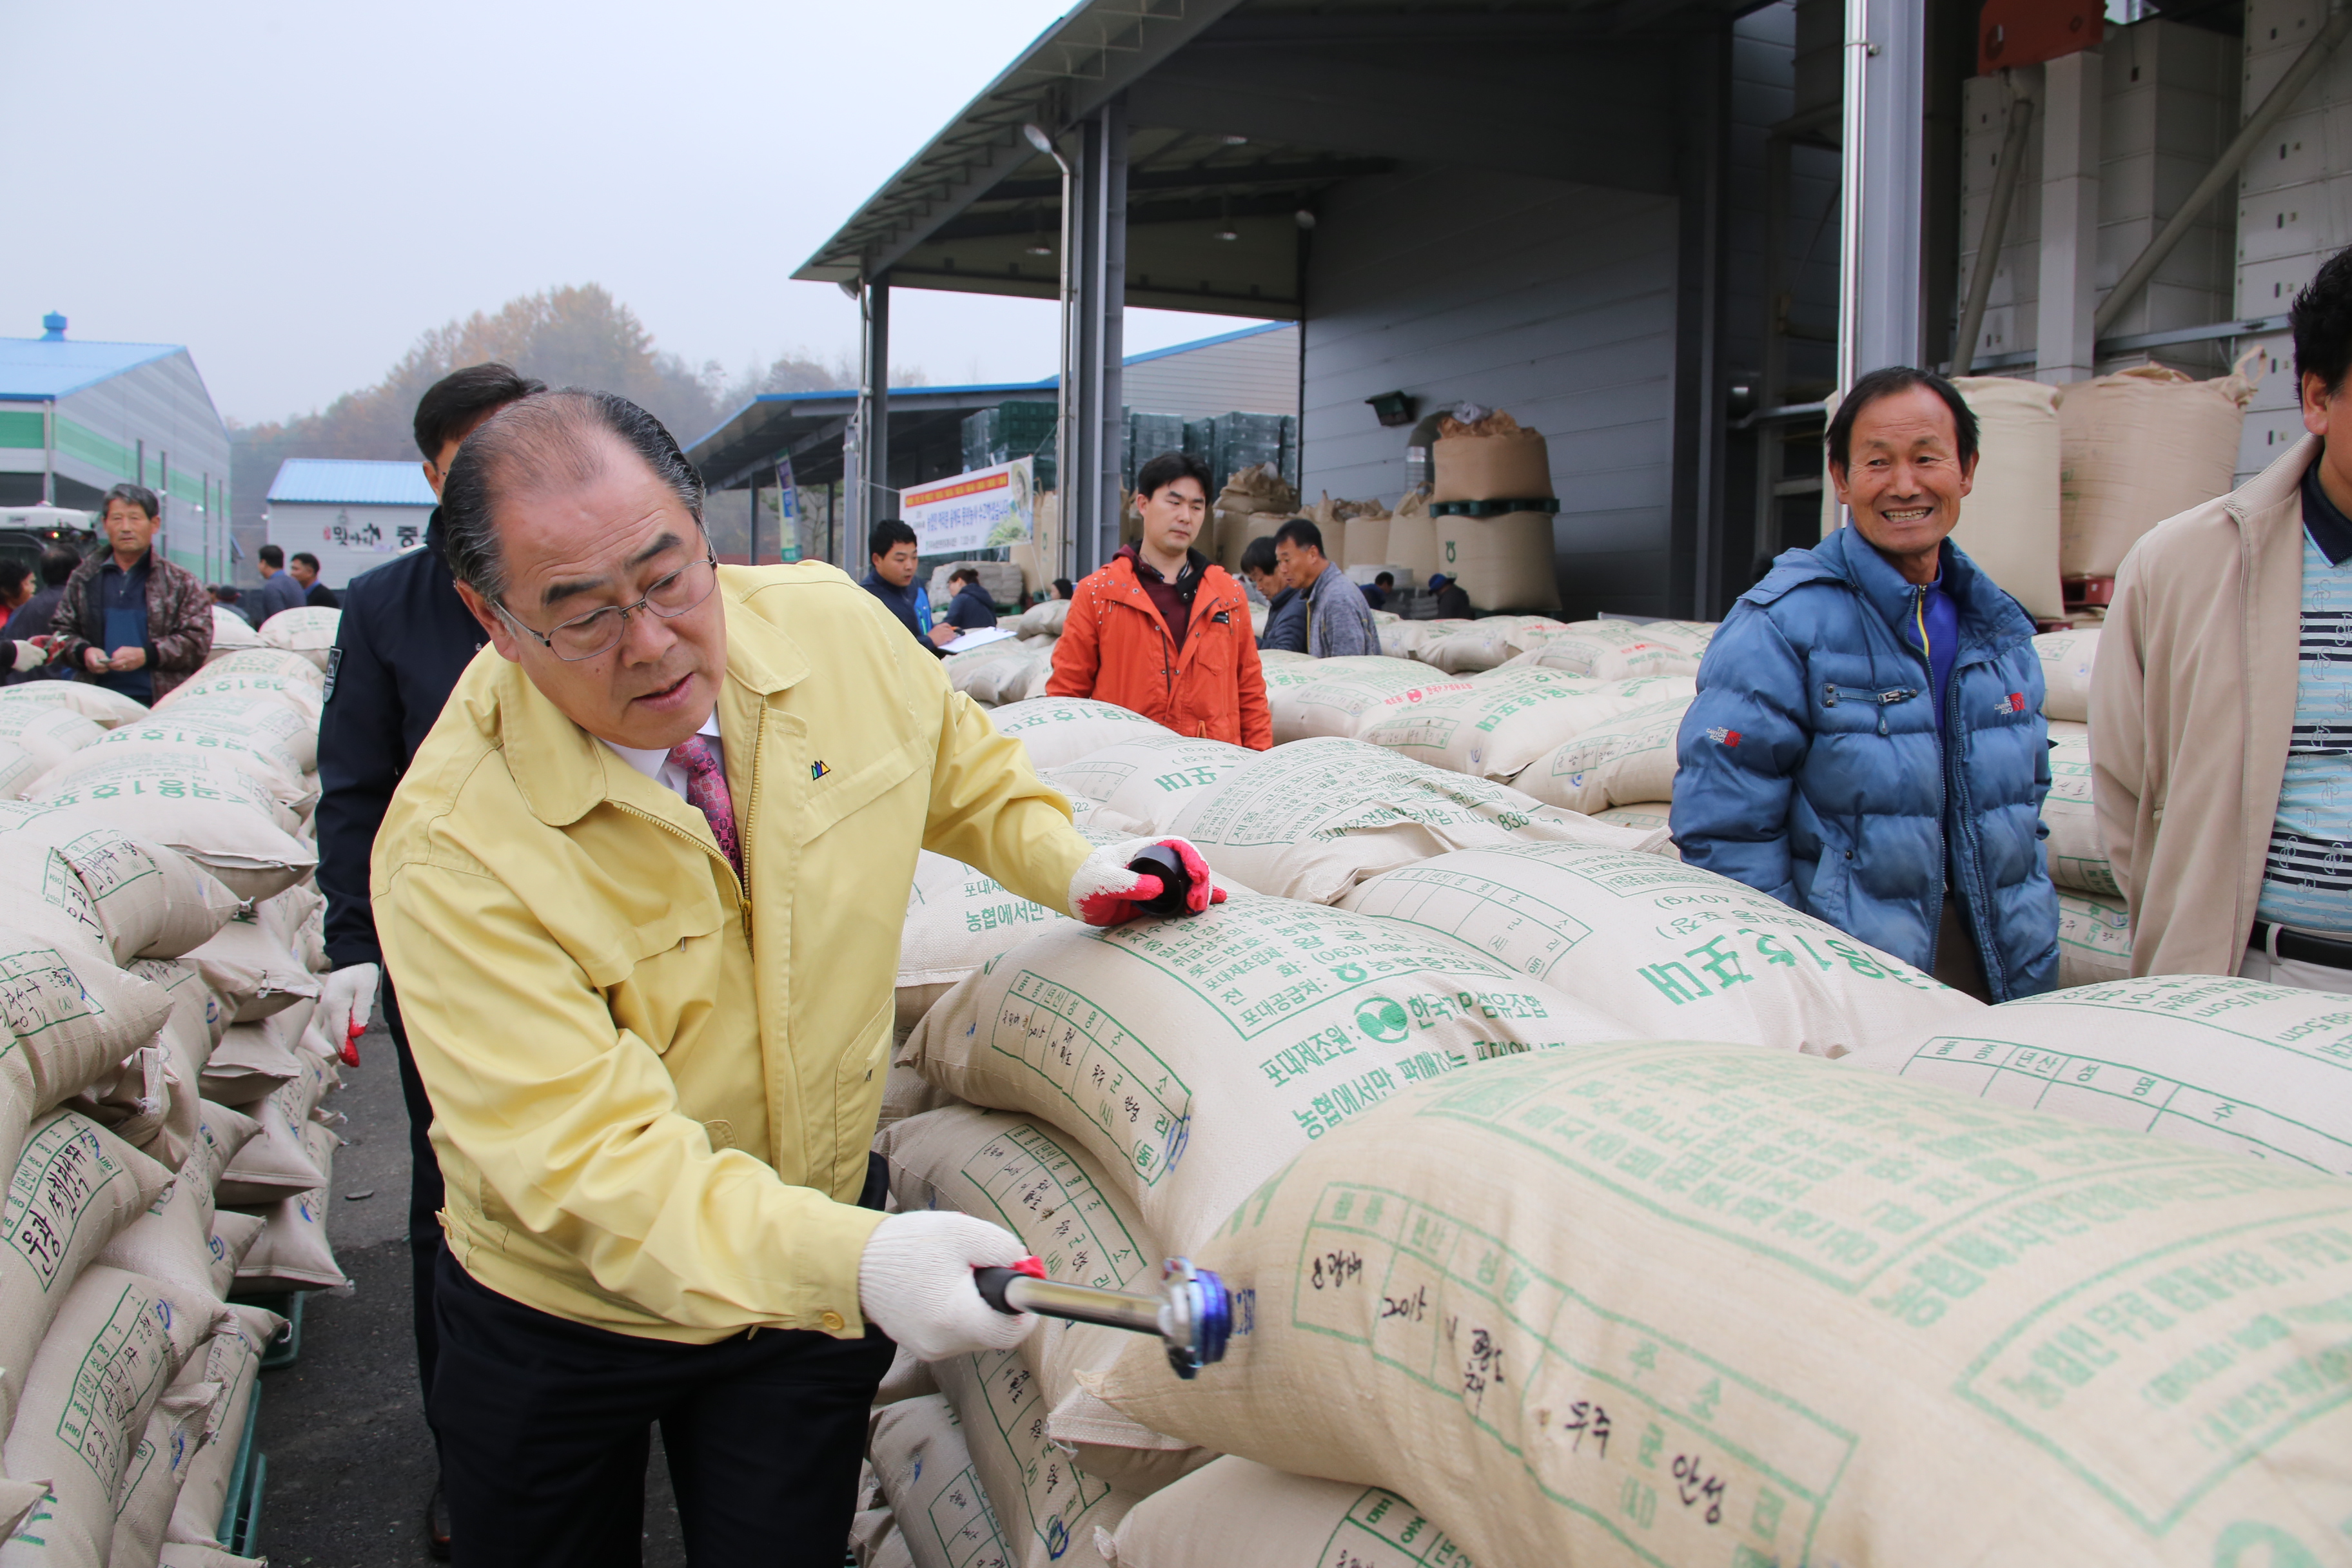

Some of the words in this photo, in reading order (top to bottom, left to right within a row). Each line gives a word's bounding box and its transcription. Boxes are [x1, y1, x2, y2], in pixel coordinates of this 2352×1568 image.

[1706, 728, 1727, 739] CANYON
[1709, 734, 1725, 743] ECHO
[1718, 726, 1729, 734] THE
[1233, 810, 1259, 838] 제품
[1202, 945, 1289, 992] 포대제조업체:
[1220, 987, 1248, 1006] 전
[1311, 945, 1369, 965] (063)
[1239, 976, 1329, 1028] 포대공급처:
[1110, 1031, 1124, 1048] 주
[1155, 1075, 1168, 1095] 소
[1259, 1020, 1361, 1088] 포대제조원:
[1110, 1073, 1123, 1094] 군
[1154, 1113, 1170, 1139] 리
[1292, 1067, 1396, 1140] 농협에서만
[2076, 1064, 2101, 1082] 성
[2132, 1077, 2157, 1097] 명
[2210, 1102, 2237, 1122] 주
[1133, 1139, 1160, 1171] (동)
[1380, 1285, 1427, 1323] 2015
[1671, 1454, 1727, 1526] 안성
